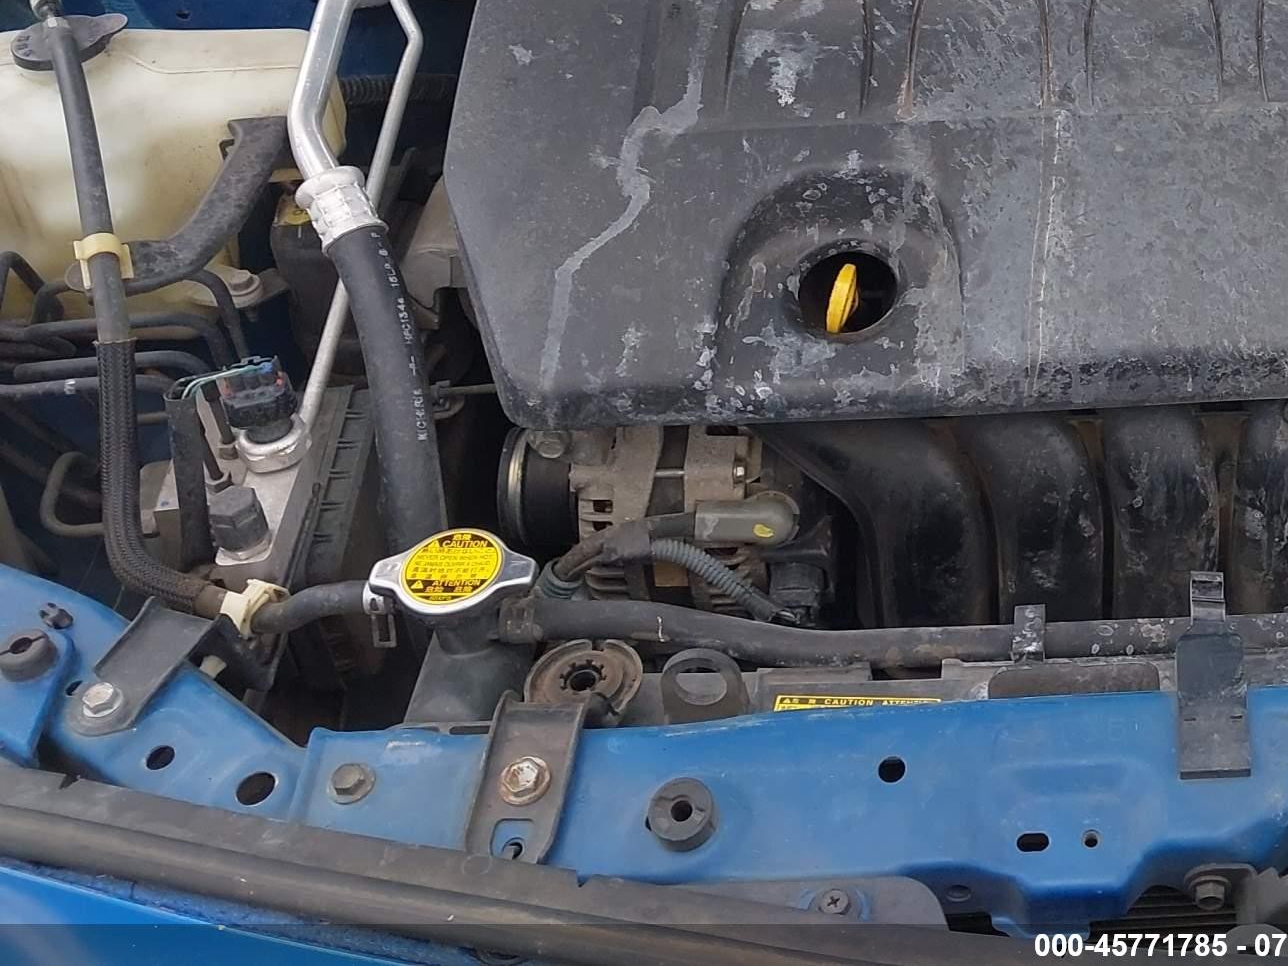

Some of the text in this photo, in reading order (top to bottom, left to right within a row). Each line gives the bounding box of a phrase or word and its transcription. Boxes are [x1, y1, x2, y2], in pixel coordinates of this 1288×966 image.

[442, 540, 488, 548] CAUTION
[432, 579, 481, 587] ATTENTION
[824, 698, 874, 706] CAUTION
